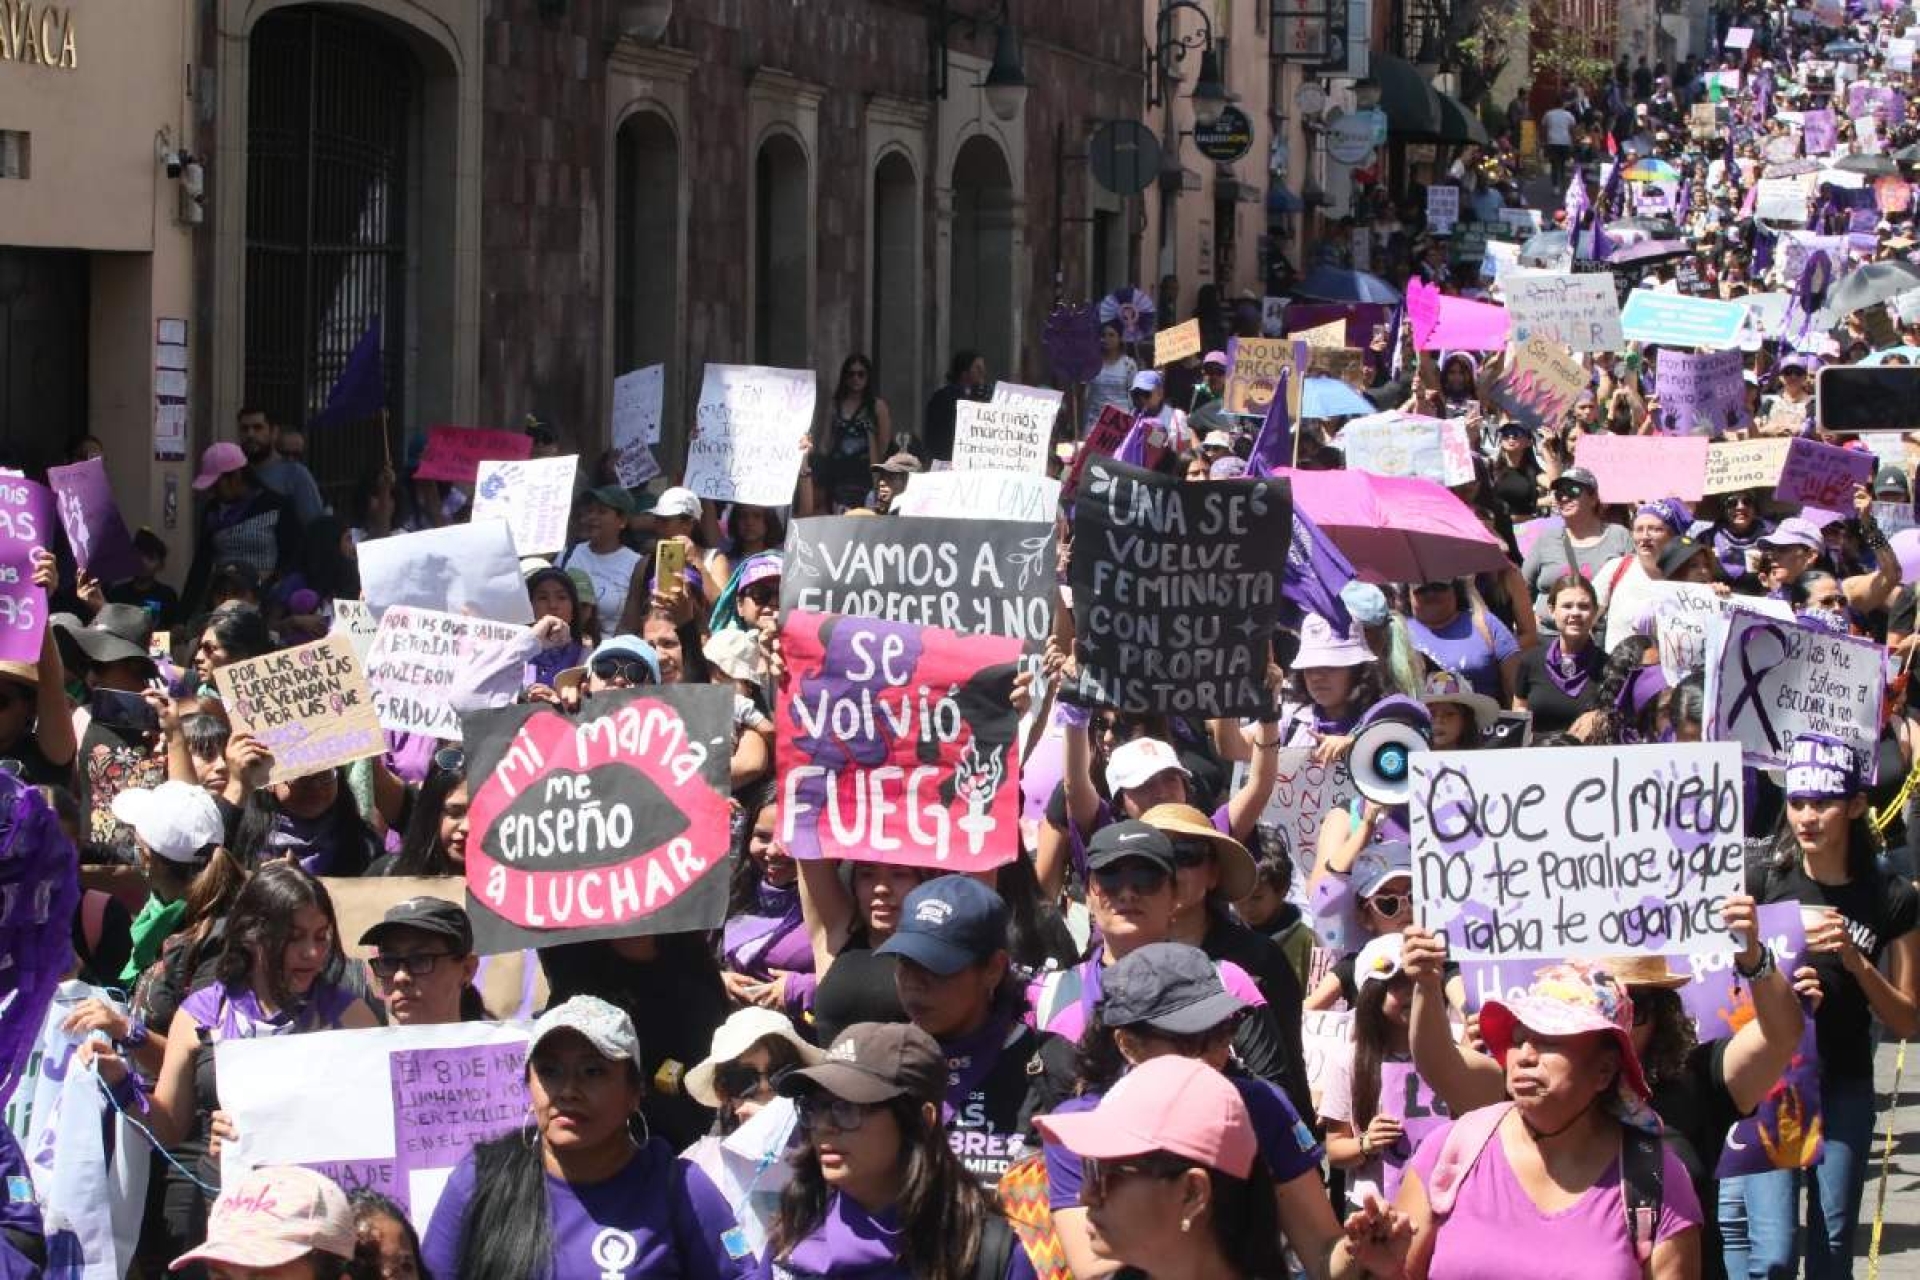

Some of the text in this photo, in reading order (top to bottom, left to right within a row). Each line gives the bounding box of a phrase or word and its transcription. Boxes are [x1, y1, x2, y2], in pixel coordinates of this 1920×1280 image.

[1108, 476, 1248, 537] UNA SE
[818, 540, 1003, 589] VAMOS A
[1105, 529, 1243, 571] VUELVE
[1093, 560, 1275, 608] FEMINISTA
[1001, 595, 1050, 641] NO
[1089, 604, 1221, 648] CON SU
[229, 663, 259, 685] POR
[264, 654, 294, 676] LAS
[234, 655, 353, 700] FUERON POR LAS
[1118, 641, 1252, 681] PROPIA
[298, 698, 327, 719] LAS
[1080, 664, 1262, 715] HISTORIA
[1427, 767, 1549, 842] Que
[1630, 761, 1739, 834] miedo
[500, 799, 634, 861] enseño
[524, 836, 706, 927] LUCHAR
[1484, 841, 1531, 906] te
[1665, 848, 1684, 901] y
[1688, 842, 1743, 893] que
[1464, 908, 1543, 955] rabia
[1554, 895, 1588, 947] te
[434, 1060, 452, 1084] 8
[459, 1056, 488, 1079] DE
